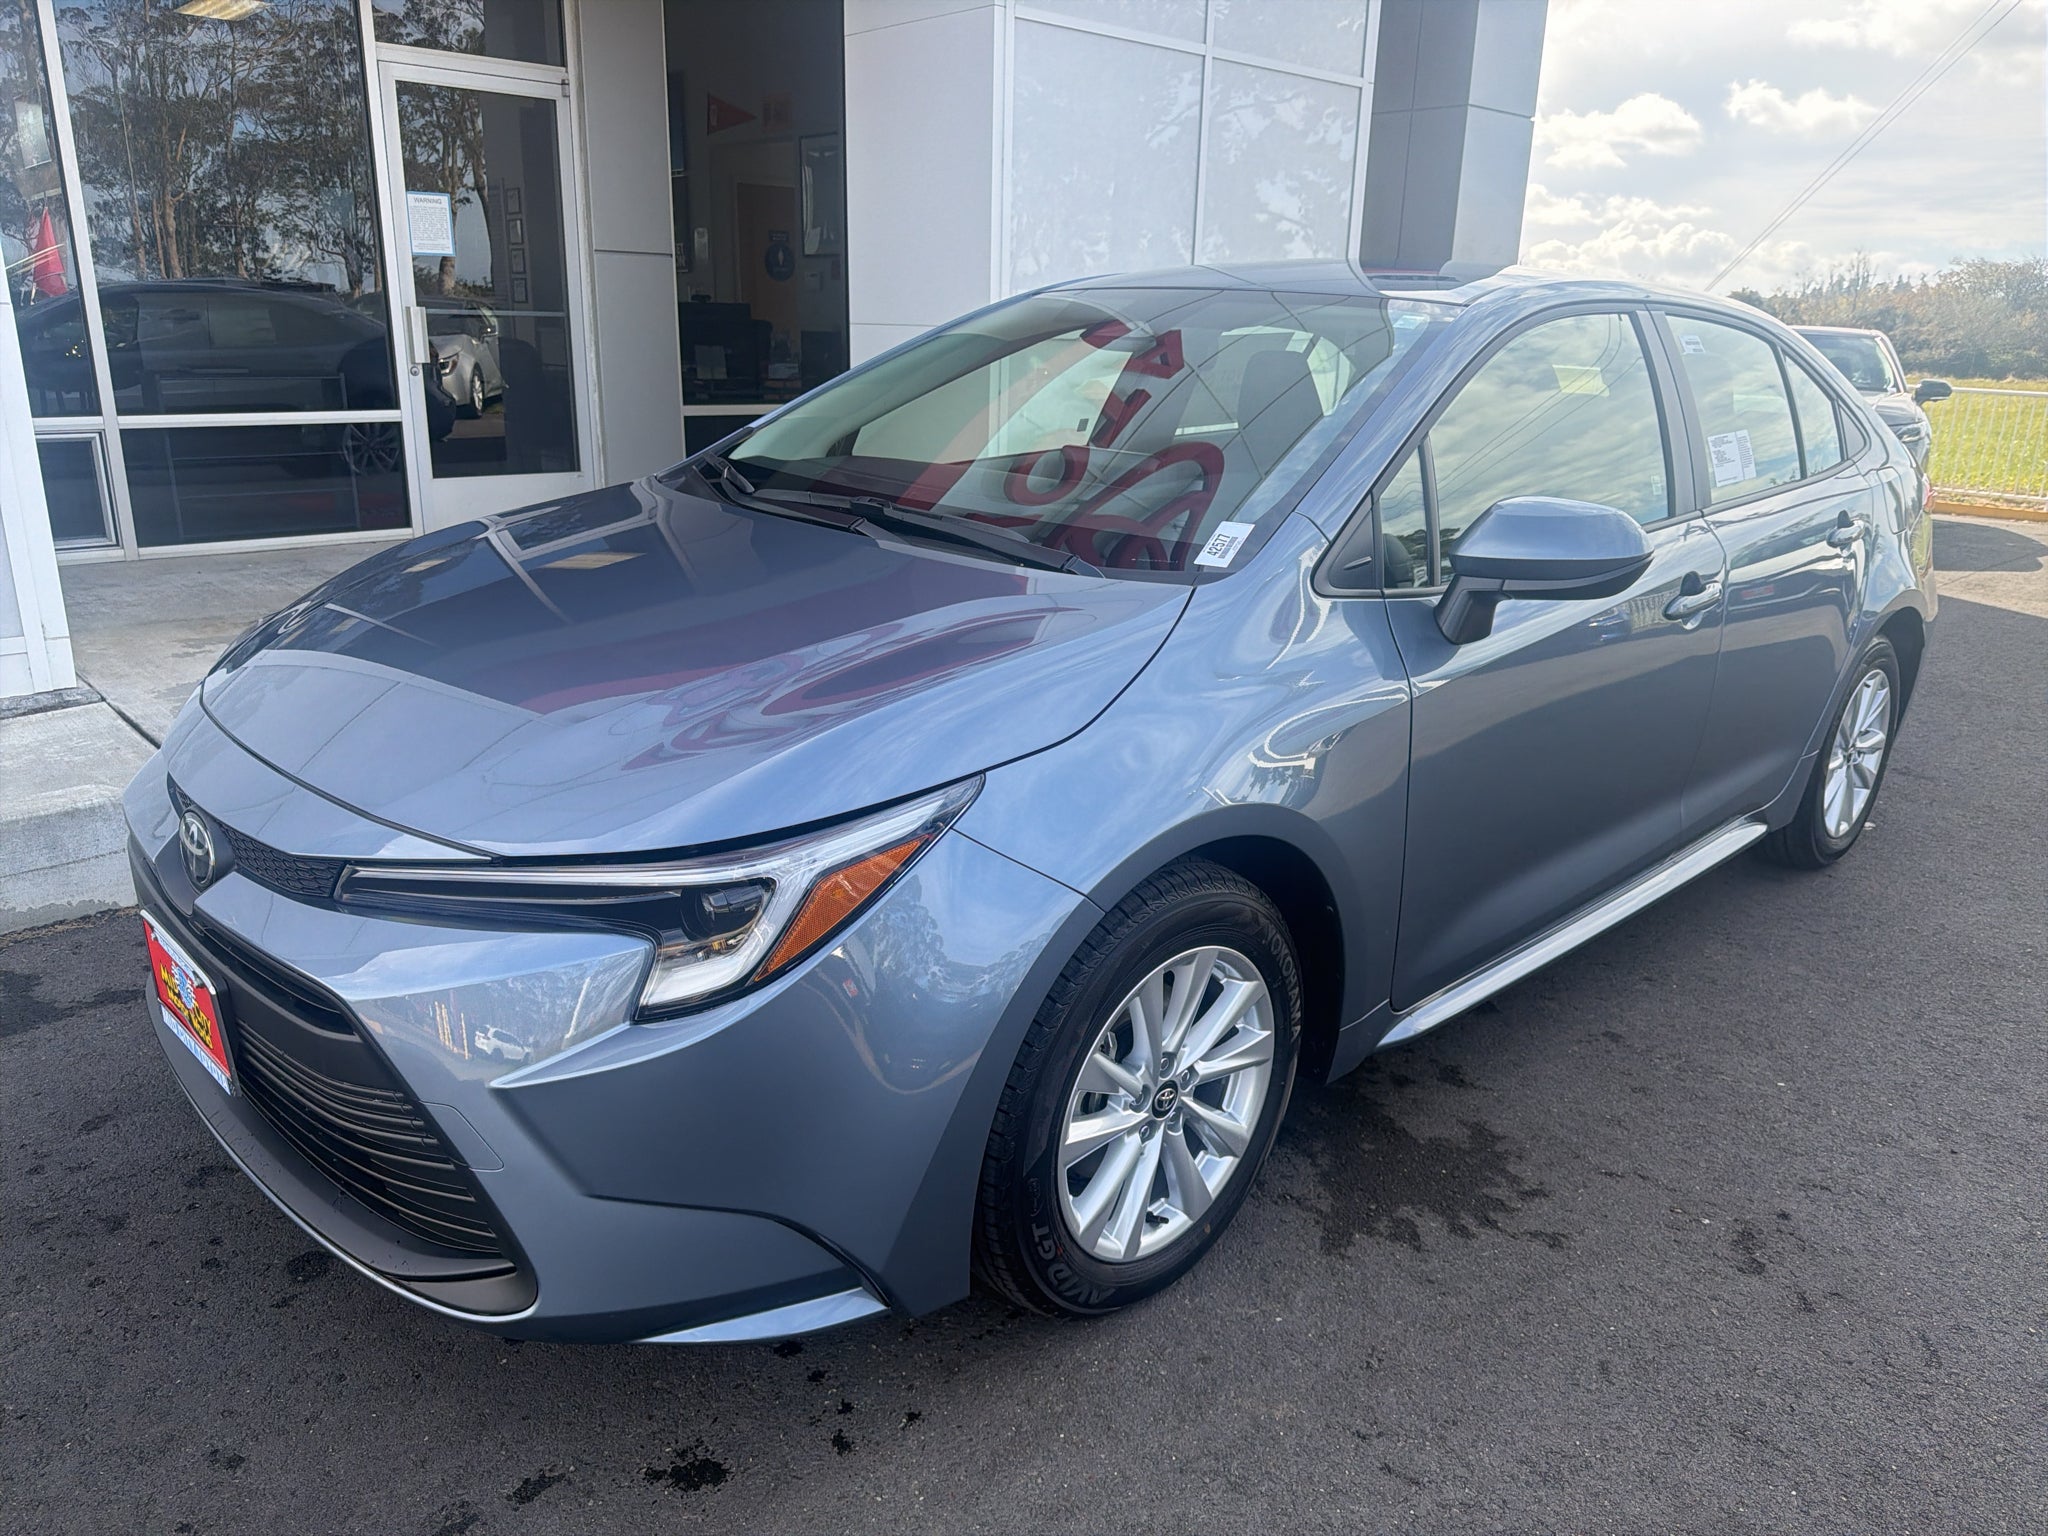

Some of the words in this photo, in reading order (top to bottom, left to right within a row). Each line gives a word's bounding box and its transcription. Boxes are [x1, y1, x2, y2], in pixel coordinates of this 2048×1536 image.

[1206, 533, 1231, 556] 42577
[1263, 922, 1302, 1043] YOKOHAMA
[1031, 1223, 1057, 1261] GT
[1047, 1261, 1116, 1305] AVID
